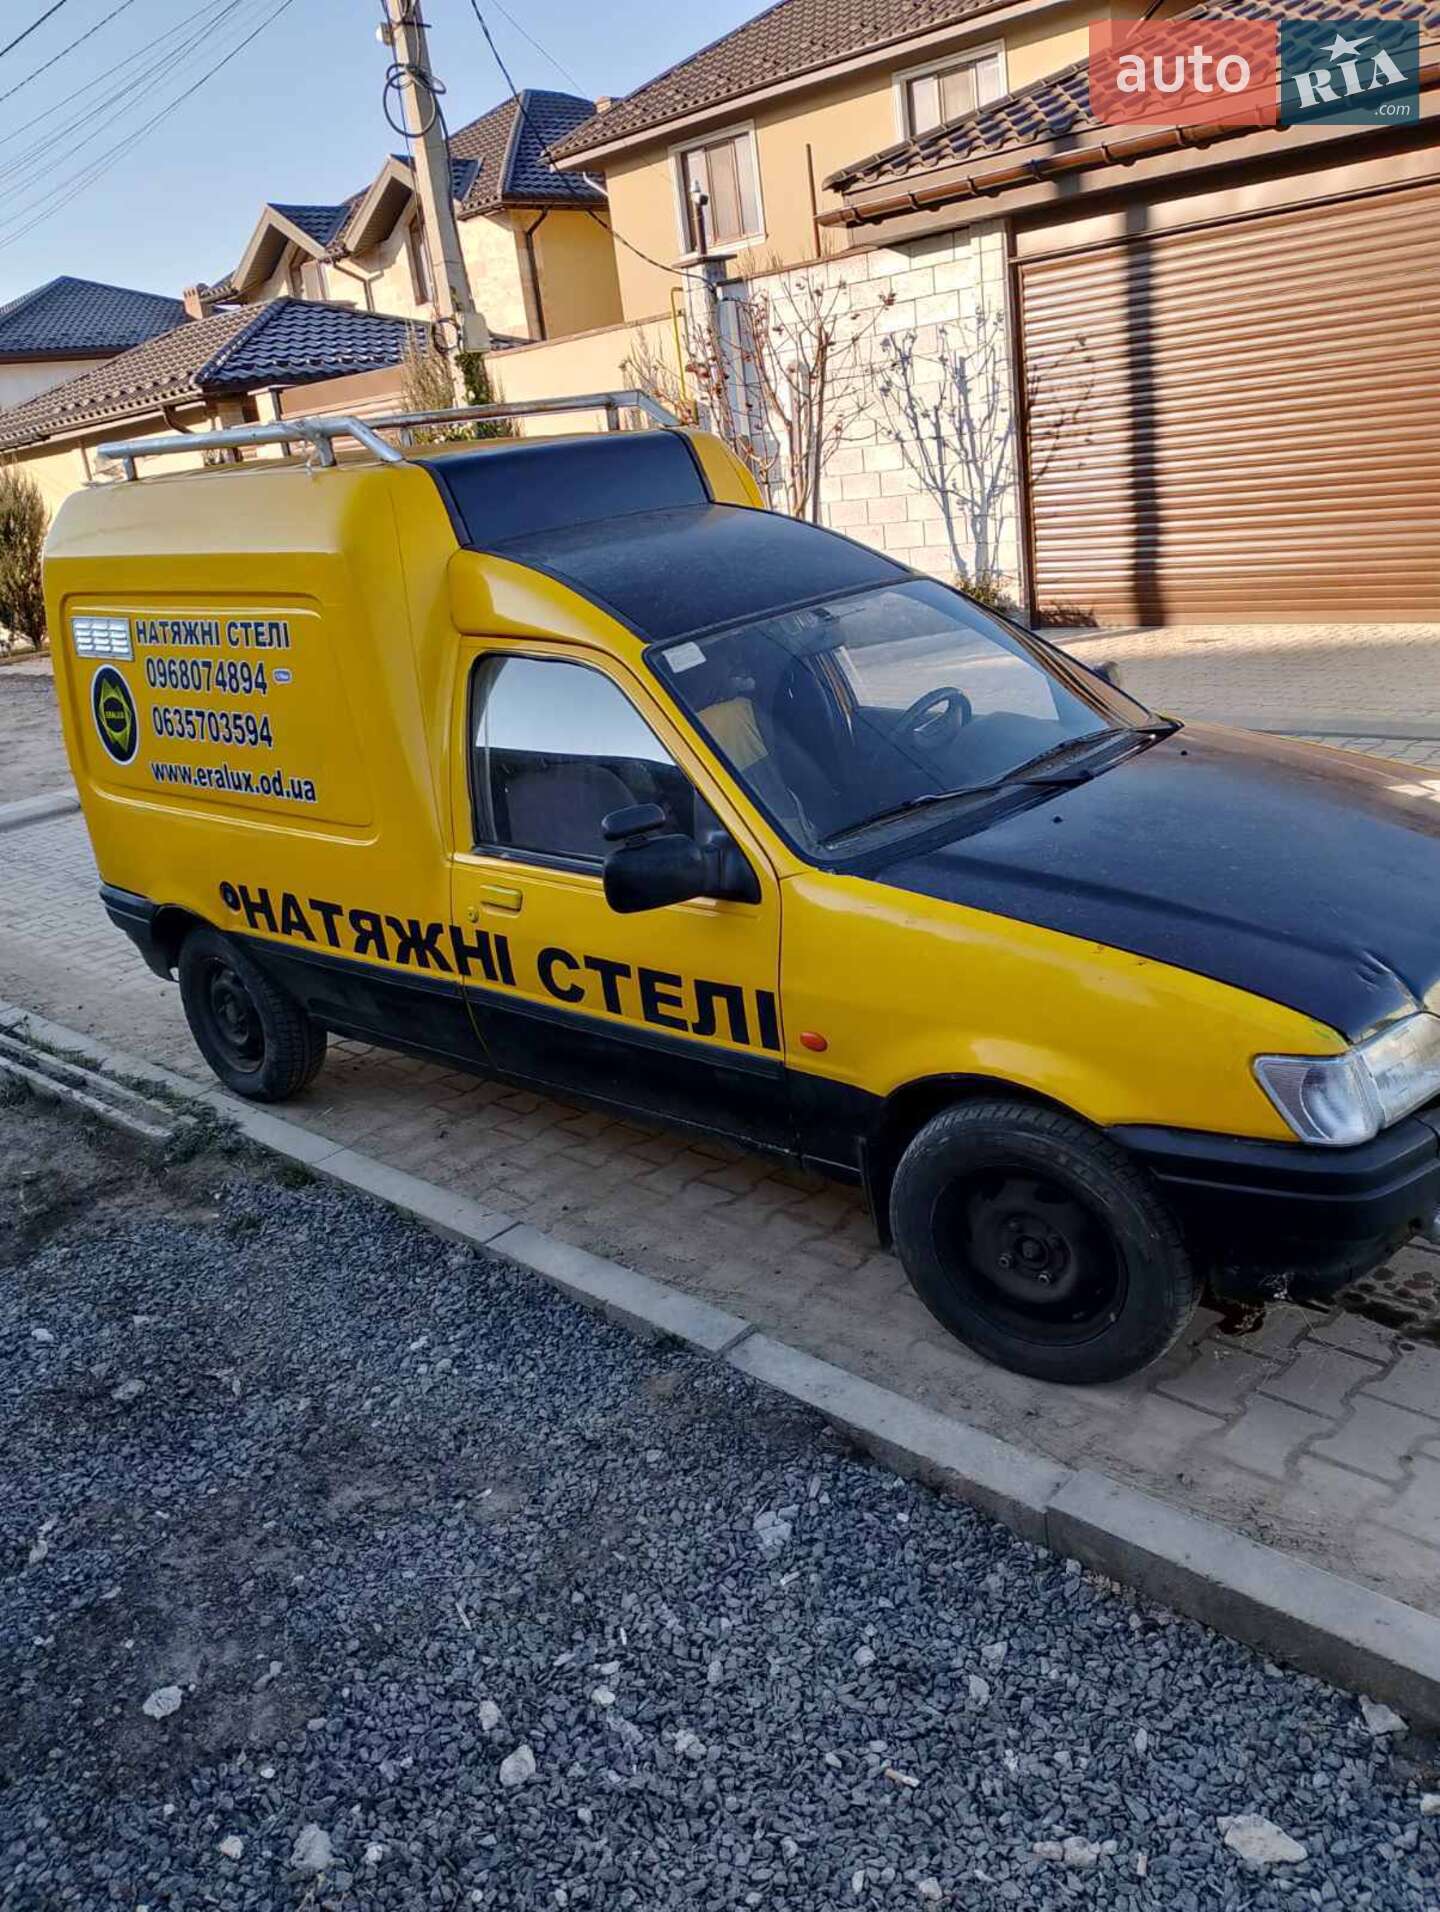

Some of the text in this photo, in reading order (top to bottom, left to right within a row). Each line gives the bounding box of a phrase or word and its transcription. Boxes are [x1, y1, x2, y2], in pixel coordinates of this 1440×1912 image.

[136, 621, 290, 648] НАТЯЖНІ СТЕЛІ
[146, 658, 268, 696] 0968074894
[152, 706, 273, 748] 0635703594
[150, 762, 317, 802] www.eralux.od.ua
[237, 884, 781, 1051] НАТЯЖНІ СТЕЛІ
